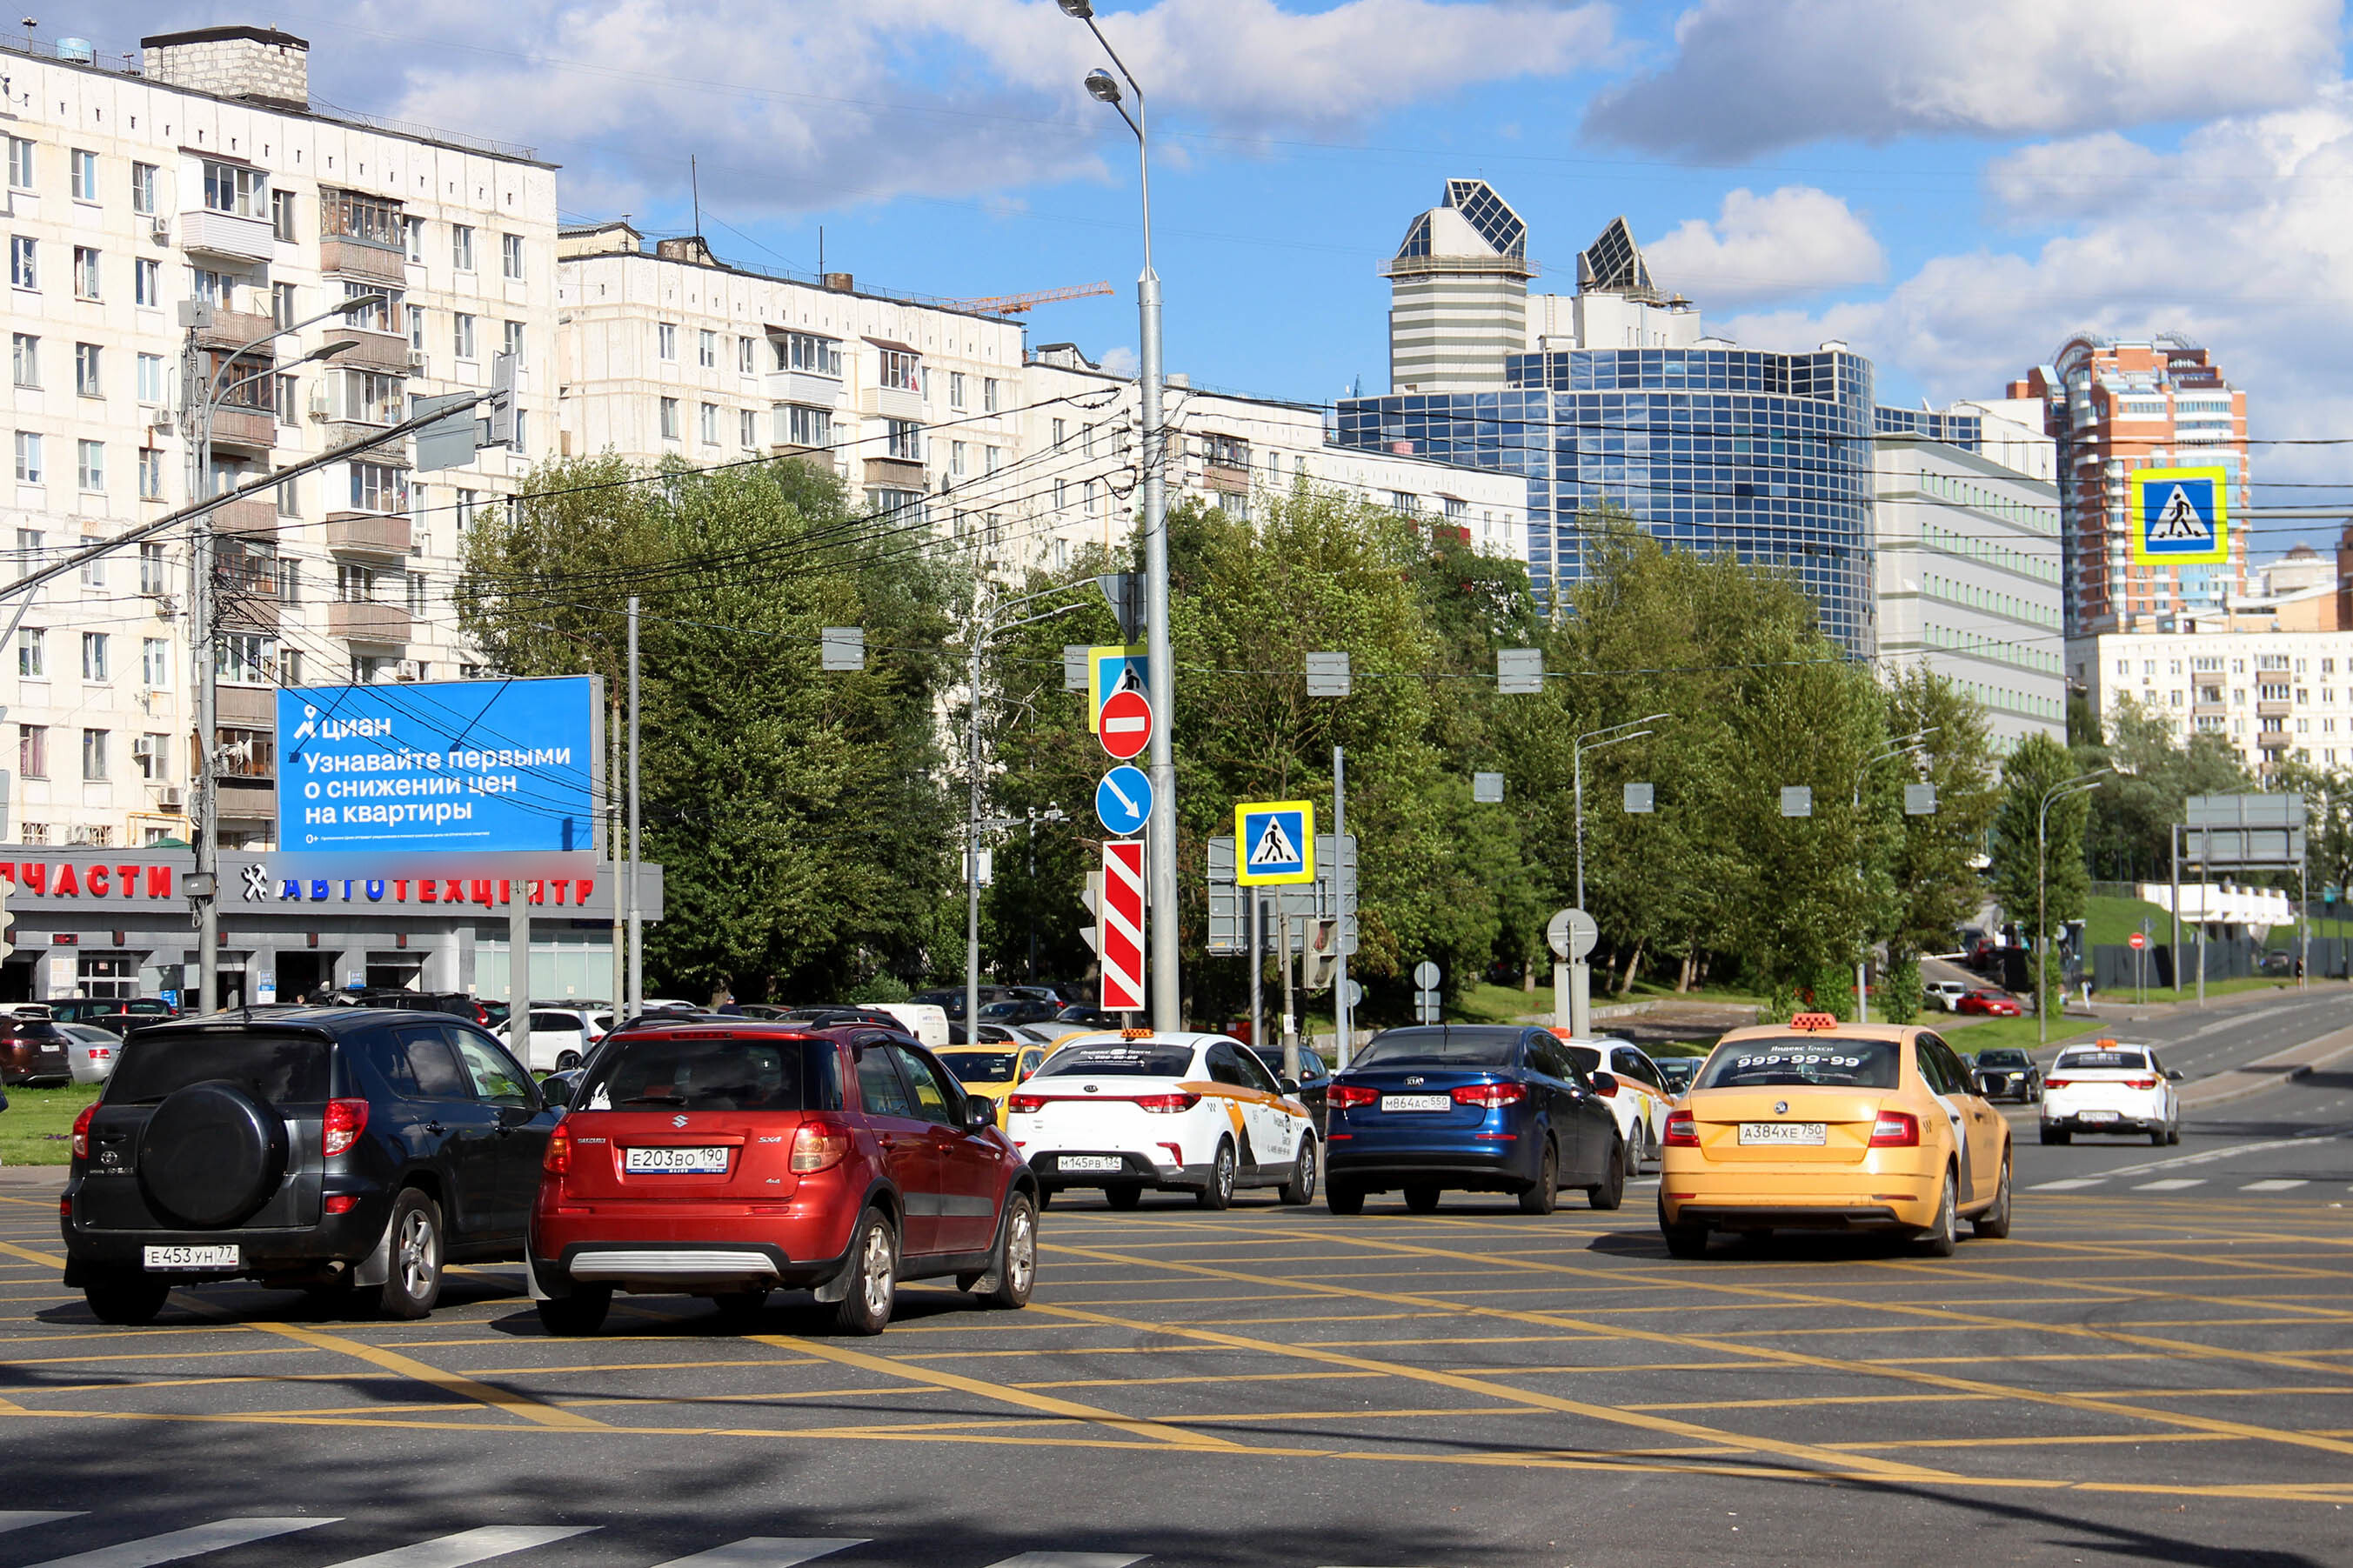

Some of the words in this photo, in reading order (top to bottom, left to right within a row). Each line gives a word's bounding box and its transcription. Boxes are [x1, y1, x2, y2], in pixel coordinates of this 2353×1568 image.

[322, 717, 391, 741] циан
[304, 747, 441, 773] Узнавайте
[448, 747, 571, 773] первыми
[304, 782, 319, 799] о
[327, 777, 461, 797] снижении
[469, 775, 517, 797] цен
[305, 806, 337, 824] на
[343, 802, 472, 827] квартиры
[305, 834, 318, 844] 0+
[276, 880, 594, 909] АВТОТЕХЦТР
[1737, 1054, 1860, 1068] 999-99-99
[1385, 1098, 1428, 1109] М864АС
[1430, 1097, 1448, 1106] 550
[1744, 1124, 1798, 1138] А384ХЕ
[1802, 1124, 1822, 1135] 750
[632, 1150, 695, 1166] Е203ВО
[699, 1148, 723, 1162] 190
[1060, 1158, 1101, 1168] М145РВ
[151, 1247, 213, 1264] Е453УН
[217, 1246, 232, 1258] 77
